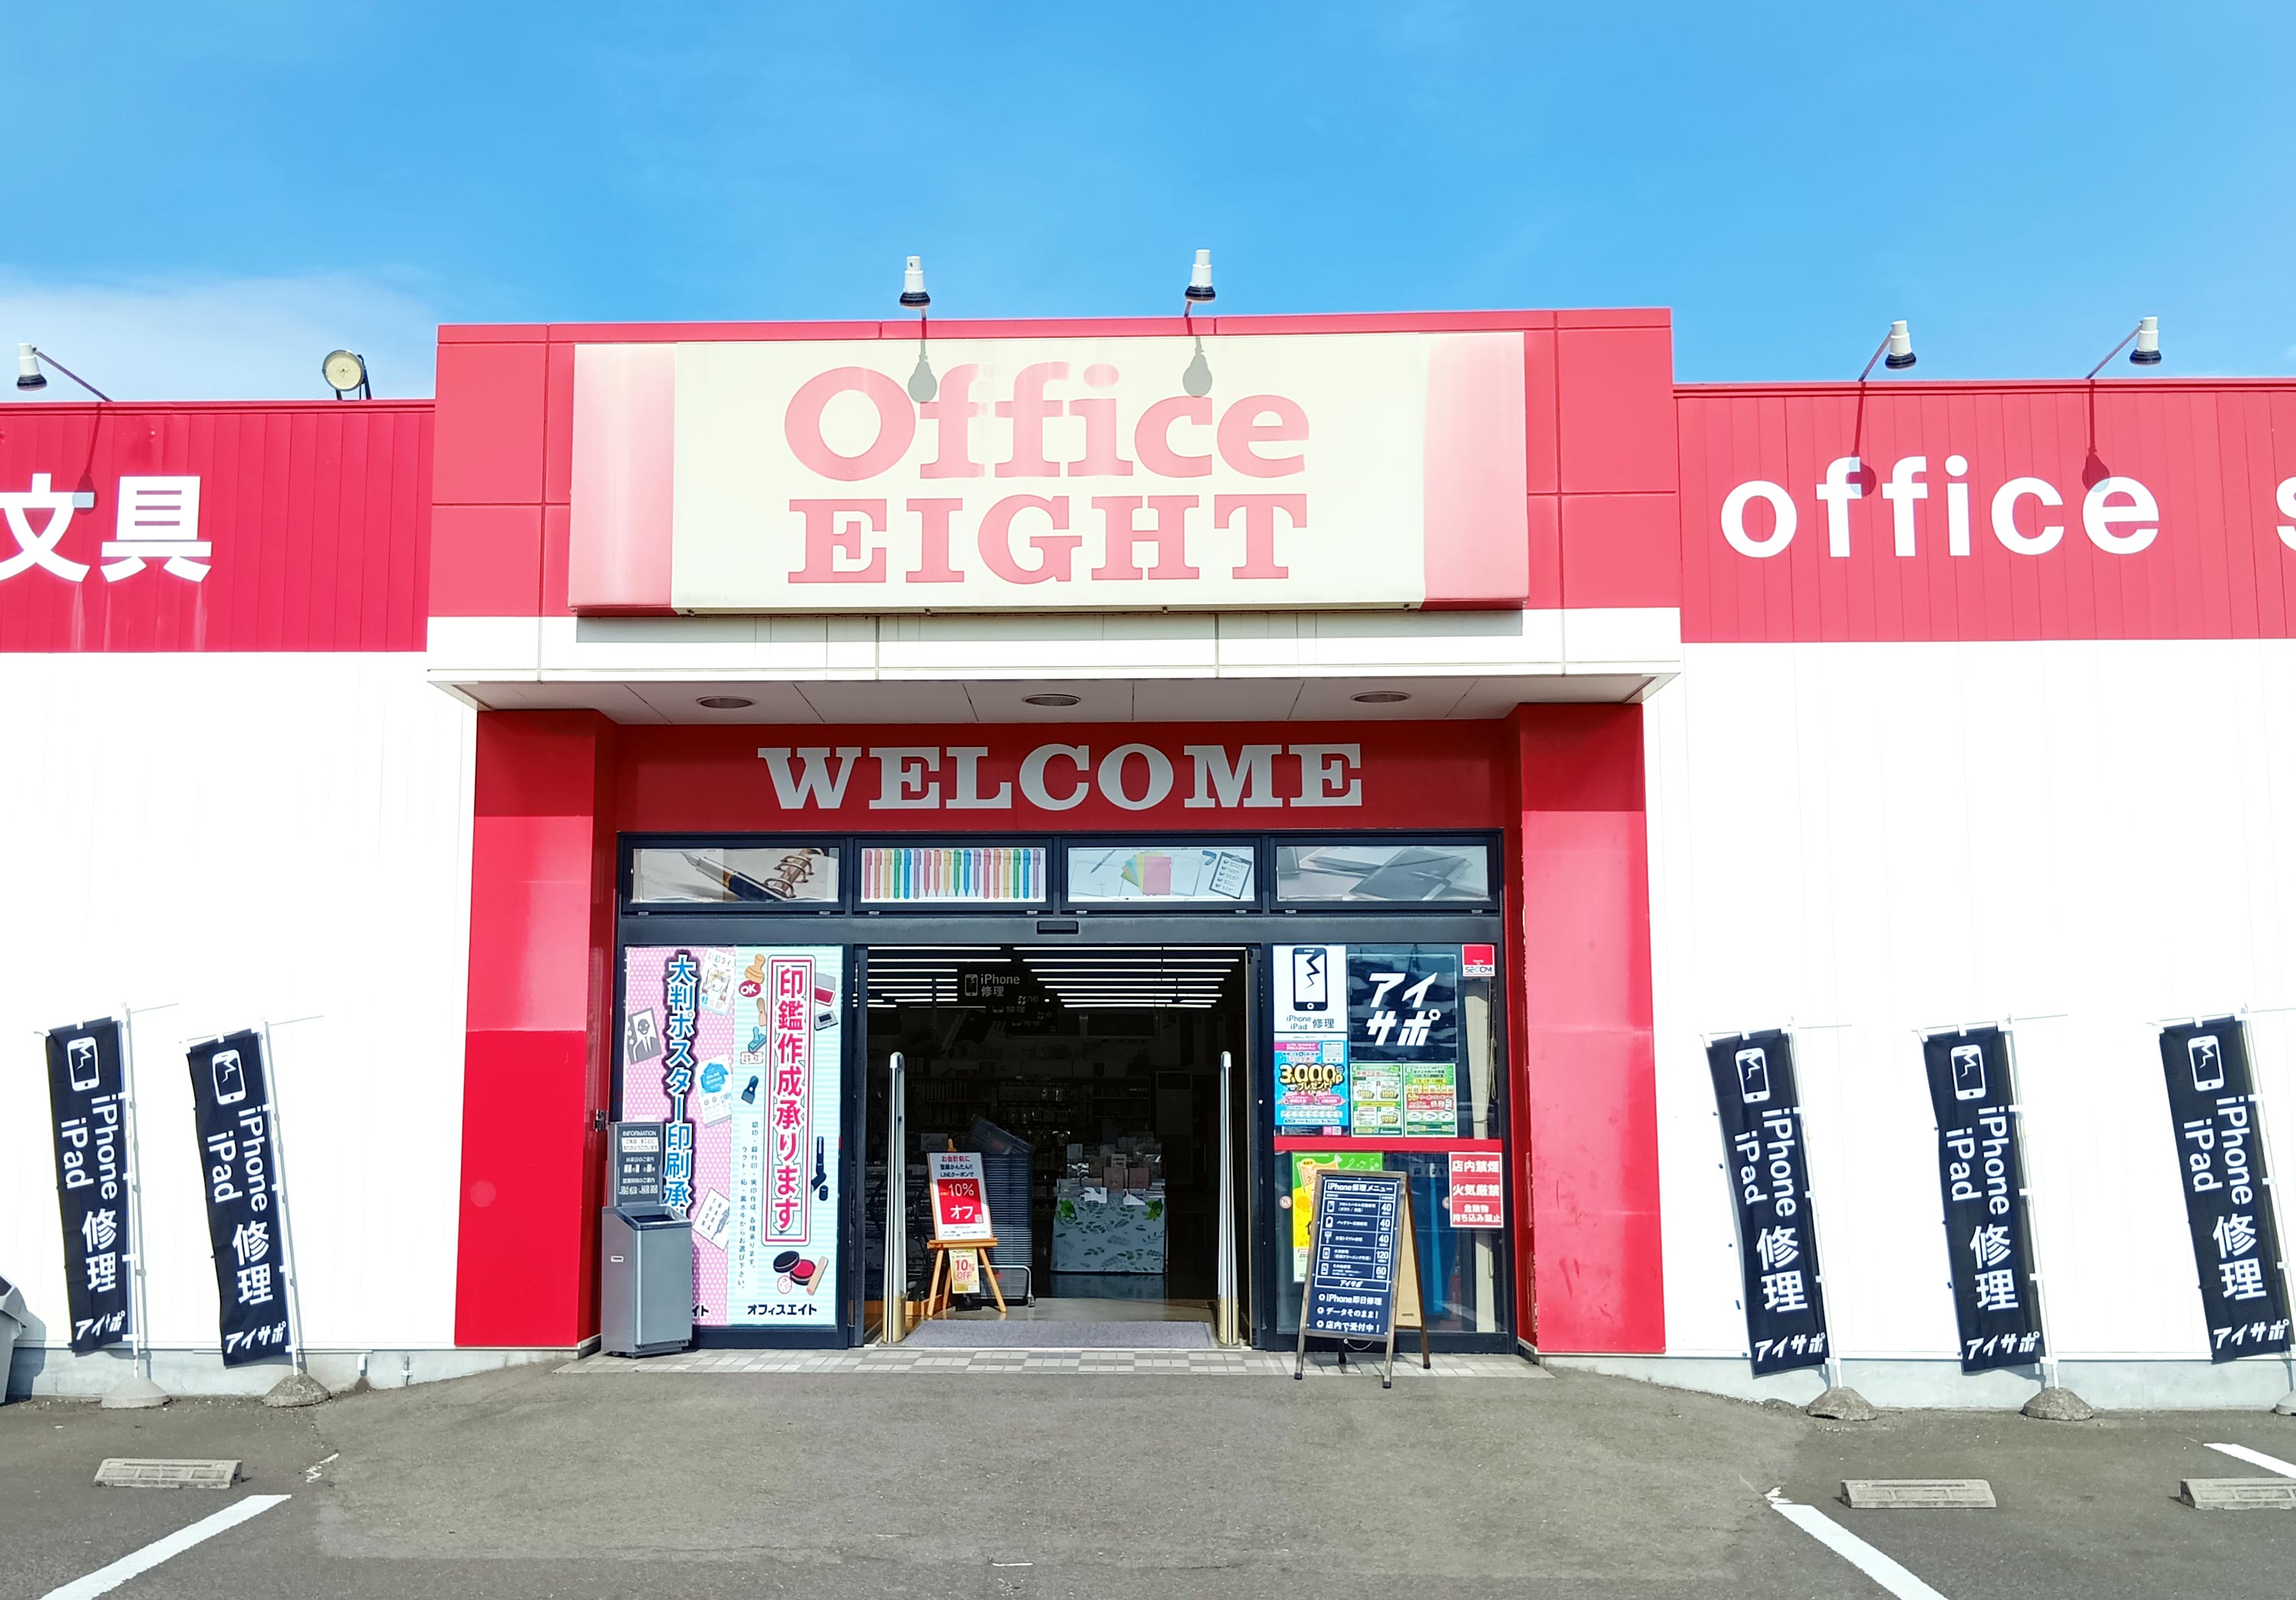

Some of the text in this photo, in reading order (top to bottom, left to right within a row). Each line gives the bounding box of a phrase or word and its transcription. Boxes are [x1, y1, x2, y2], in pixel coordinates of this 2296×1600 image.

[784, 361, 1309, 482] Office
[1720, 455, 2160, 558] office
[0, 473, 212, 582] 文具
[788, 494, 1307, 585] EIGHT
[758, 743, 1362, 810] WELCOME
[740, 984, 757, 994] OK
[980, 974, 1020, 984] iPhone
[981, 986, 1004, 997] 修理
[1368, 971, 1438, 1008] アイ
[1313, 1018, 1334, 1028] 修理
[1366, 1008, 1441, 1046] サポ
[663, 954, 697, 1215] 大判ポスター印刷承
[775, 968, 804, 1229] 印鑑作成承ります
[61, 1118, 93, 1189] iPad
[207, 1131, 243, 1203] iPad
[1452, 1161, 1499, 1172] 店内禁煙
[1734, 1130, 1767, 1205] iPad
[1945, 1127, 1981, 1202] iPad
[2183, 1118, 2223, 1193] iPad
[82, 1094, 119, 1293] iPhone 修理
[948, 1184, 974, 1197] 10%
[1327, 1183, 1392, 1192] iPhone修理メニュー
[1453, 1184, 1499, 1196] 火気厳禁
[2213, 1096, 2267, 1302] iPhone 修理
[233, 1106, 273, 1305] iPhone 修理
[950, 1204, 974, 1220] オフ
[1381, 1203, 1391, 1212] 40
[1453, 1214, 1501, 1223] 持ち込み禁止
[1464, 1204, 1489, 1213] 危険物
[1756, 1107, 1808, 1314] iPhone 修理
[1968, 1106, 2018, 1311] iPhone 修理
[1380, 1219, 1390, 1227] 40
[1378, 1235, 1389, 1243] 40
[1376, 1251, 1388, 1259] 120
[1375, 1266, 1387, 1275] 60
[748, 1304, 817, 1315] オフィスエイト
[1326, 1293, 1382, 1305] iPhone即日修理
[1326, 1308, 1378, 1319] データそのまま!
[226, 1321, 286, 1353] アイサポ
[1754, 1331, 1826, 1361] アイサポ
[1966, 1331, 2040, 1360] アイサポ
[2213, 1318, 2290, 1349] アイサポ
